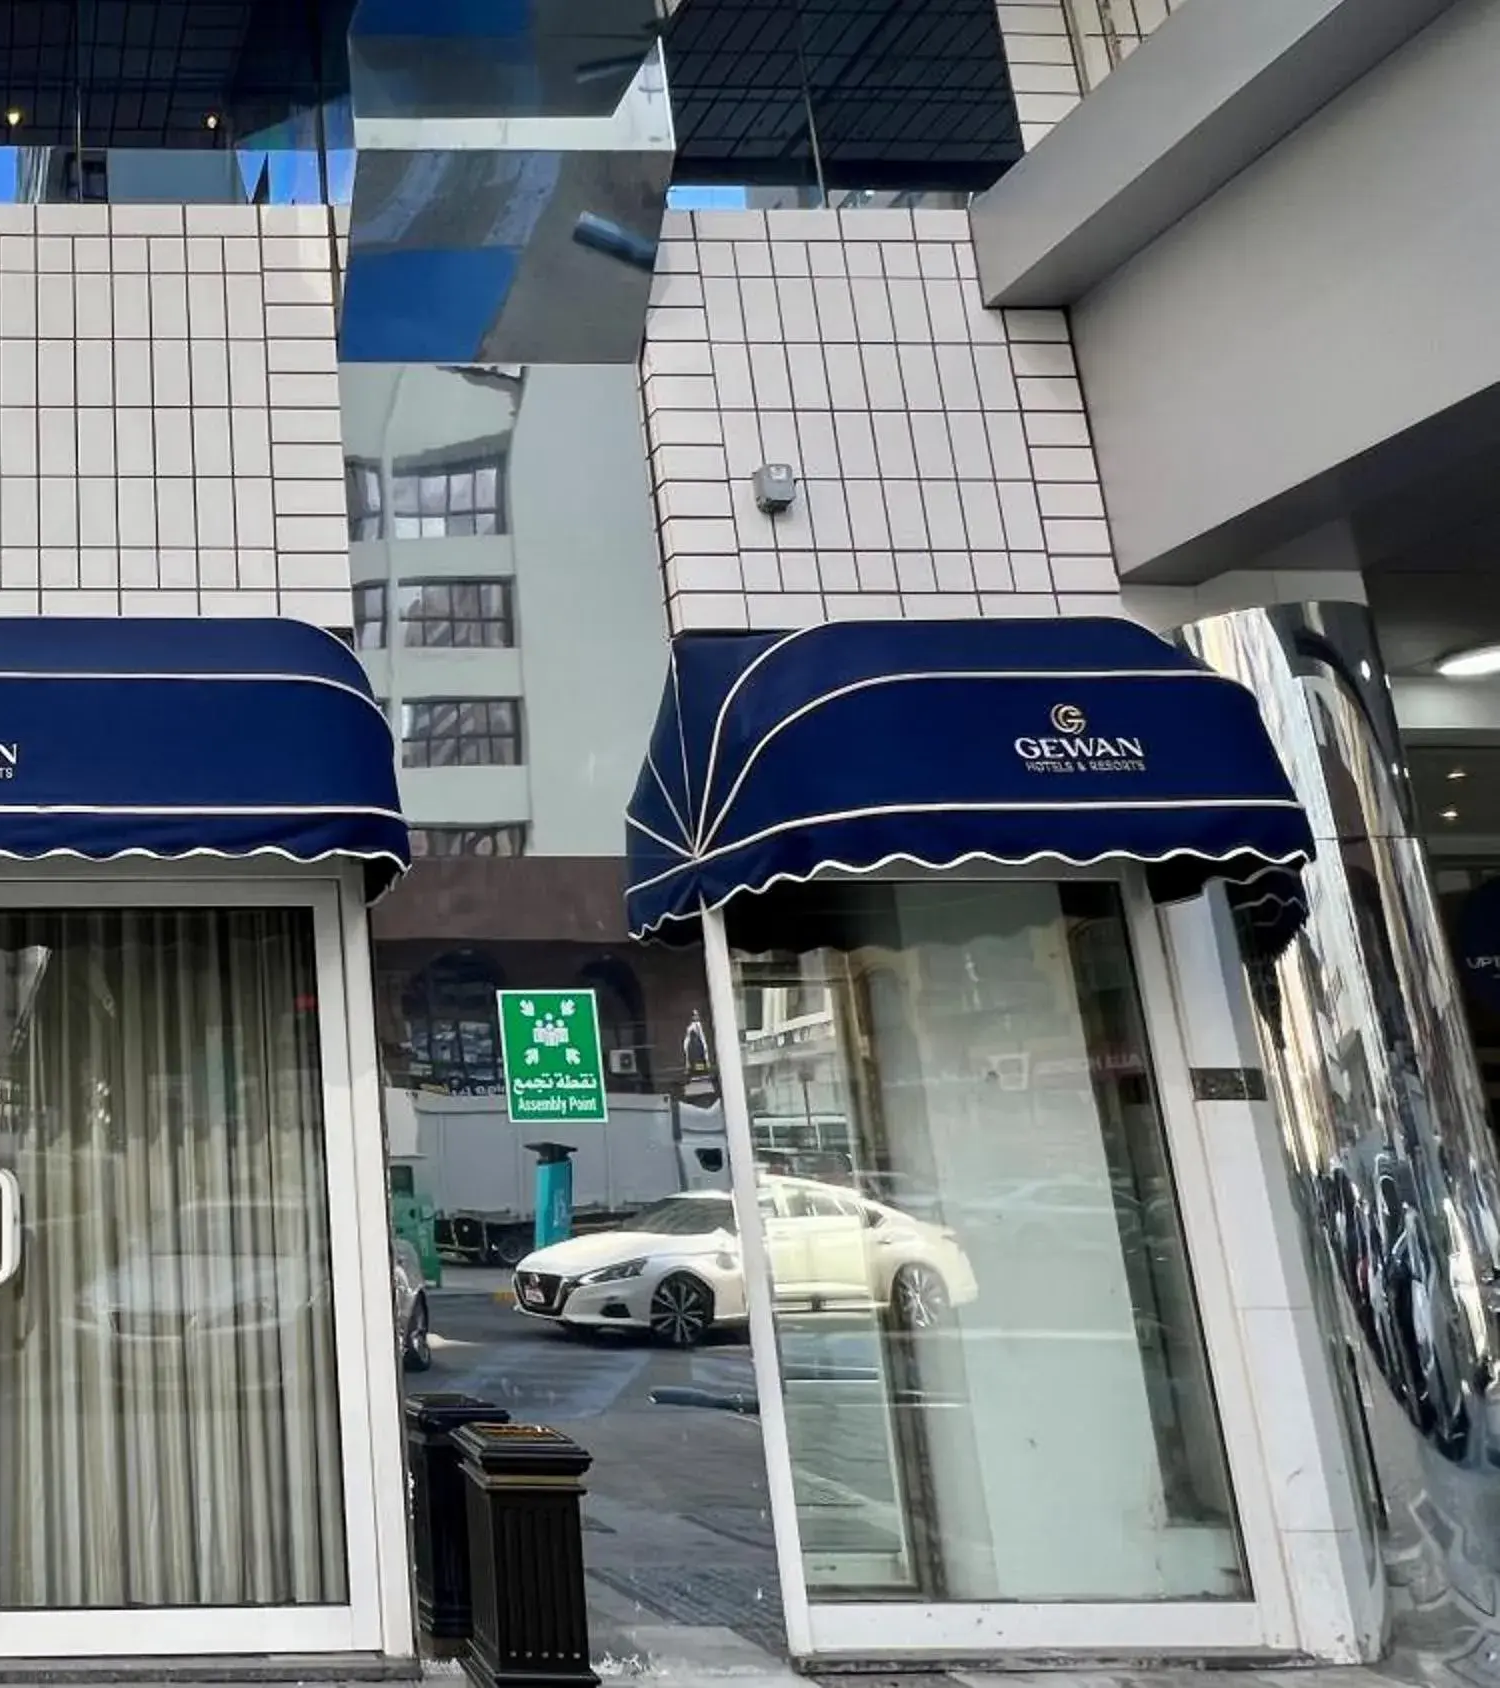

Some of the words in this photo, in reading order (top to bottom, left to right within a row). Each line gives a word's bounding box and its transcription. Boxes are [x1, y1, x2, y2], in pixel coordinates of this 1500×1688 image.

[1014, 737, 1145, 759] GEWAN
[1025, 761, 1075, 774] HOTELS
[1076, 761, 1087, 773] &
[1089, 759, 1147, 772] RESORTS
[513, 1072, 554, 1095] تجمع
[556, 1072, 597, 1089] نقطة
[518, 1095, 566, 1115] Assembly
[568, 1096, 597, 1111] Point
